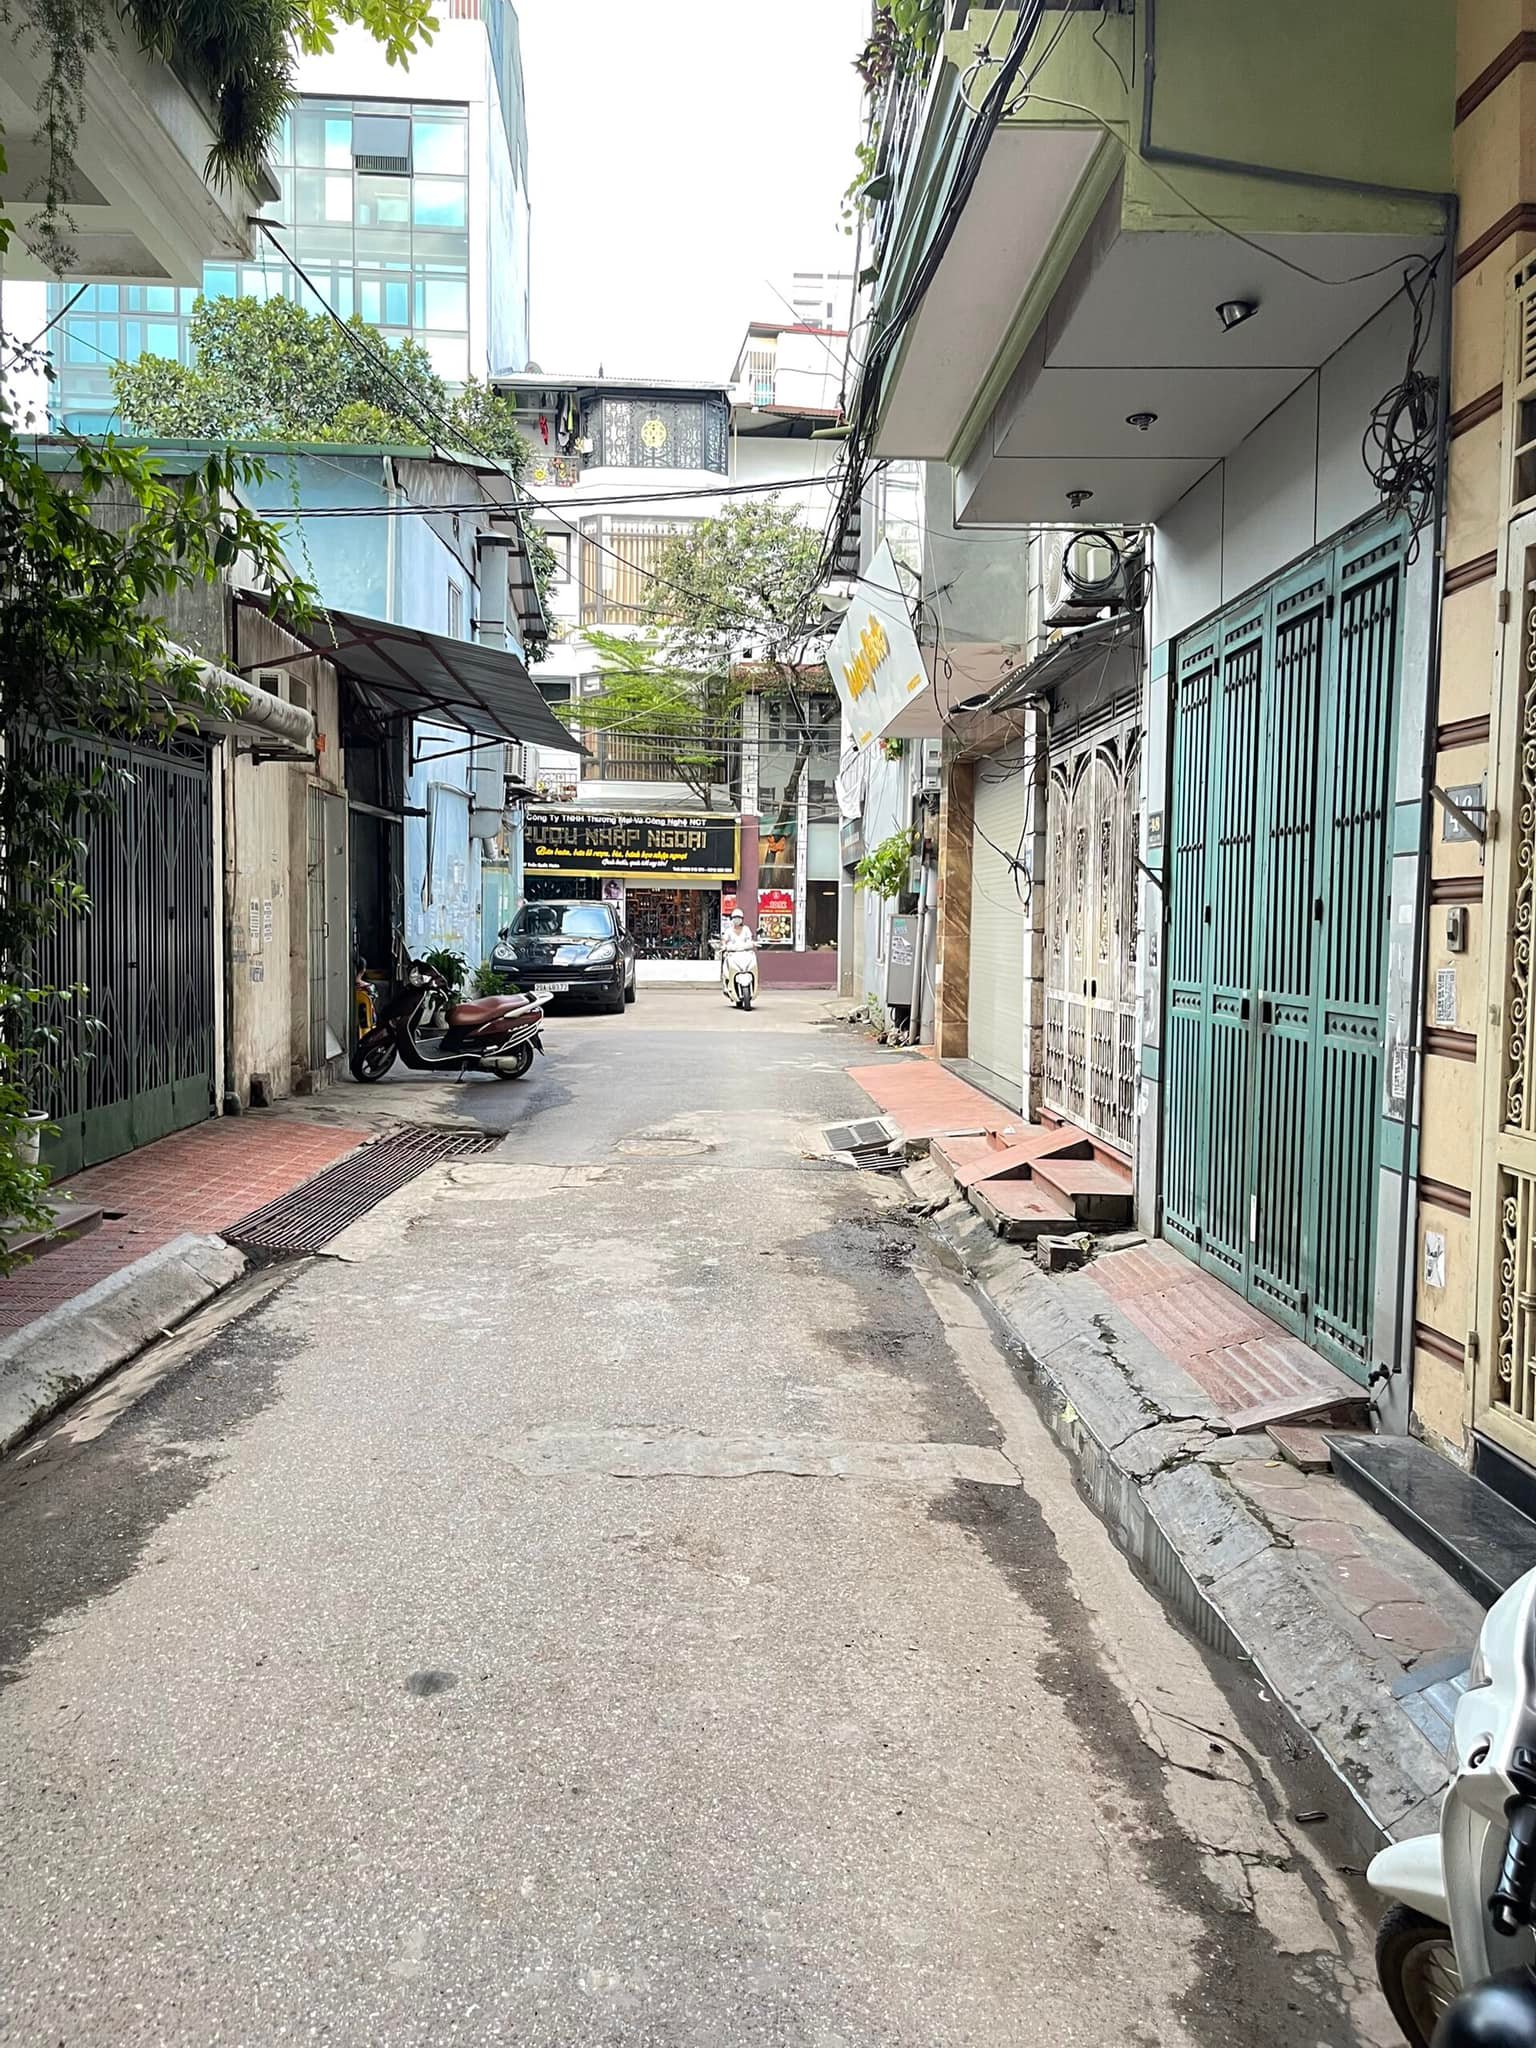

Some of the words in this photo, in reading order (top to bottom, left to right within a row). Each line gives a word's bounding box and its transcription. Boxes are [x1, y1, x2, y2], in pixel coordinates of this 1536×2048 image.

[526, 813, 547, 823] Công
[549, 814, 560, 823] Ty
[561, 815, 585, 823] TNHH
[647, 830, 707, 851] NGOẠI
